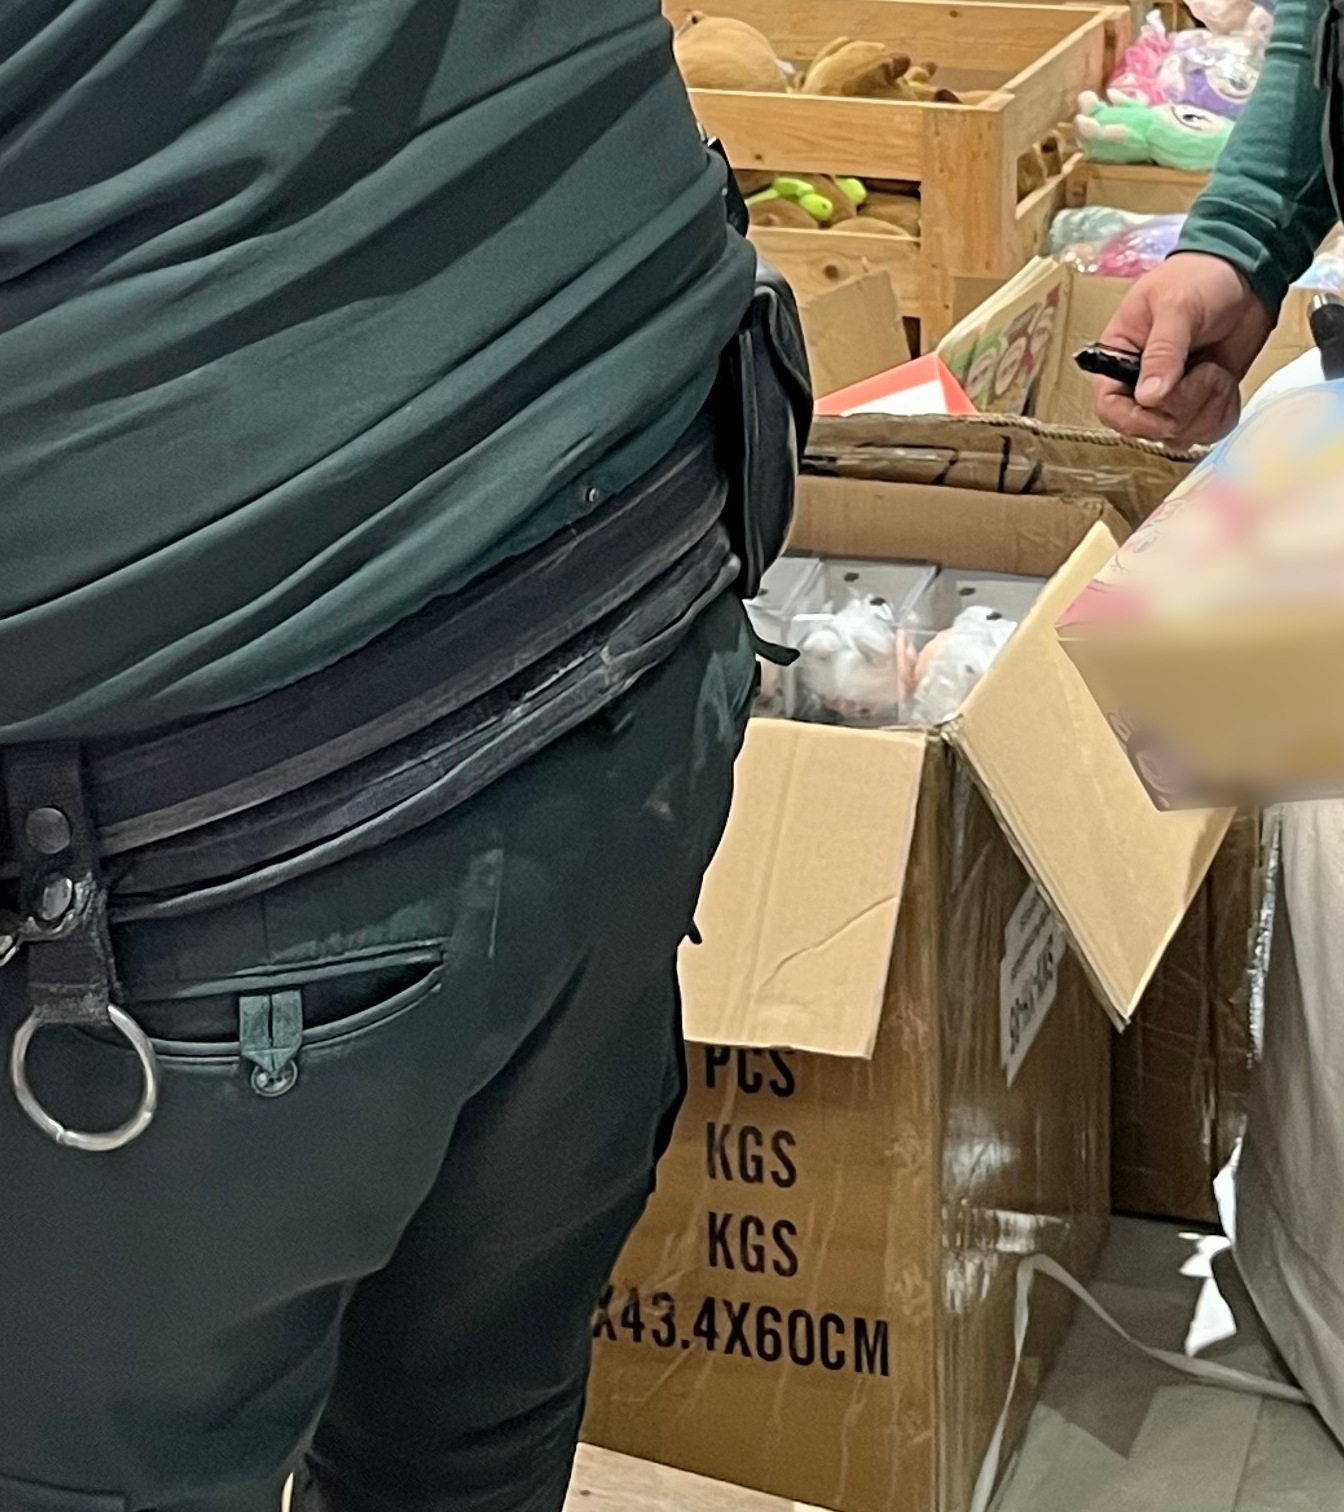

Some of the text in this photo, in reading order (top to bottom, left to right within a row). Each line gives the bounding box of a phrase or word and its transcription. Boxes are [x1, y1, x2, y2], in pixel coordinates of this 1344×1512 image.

[705, 1044, 795, 1098] PCS
[706, 1121, 798, 1188] KGS
[708, 1210, 799, 1278] KGS
[592, 1284, 890, 1377] X43.4X60CM
